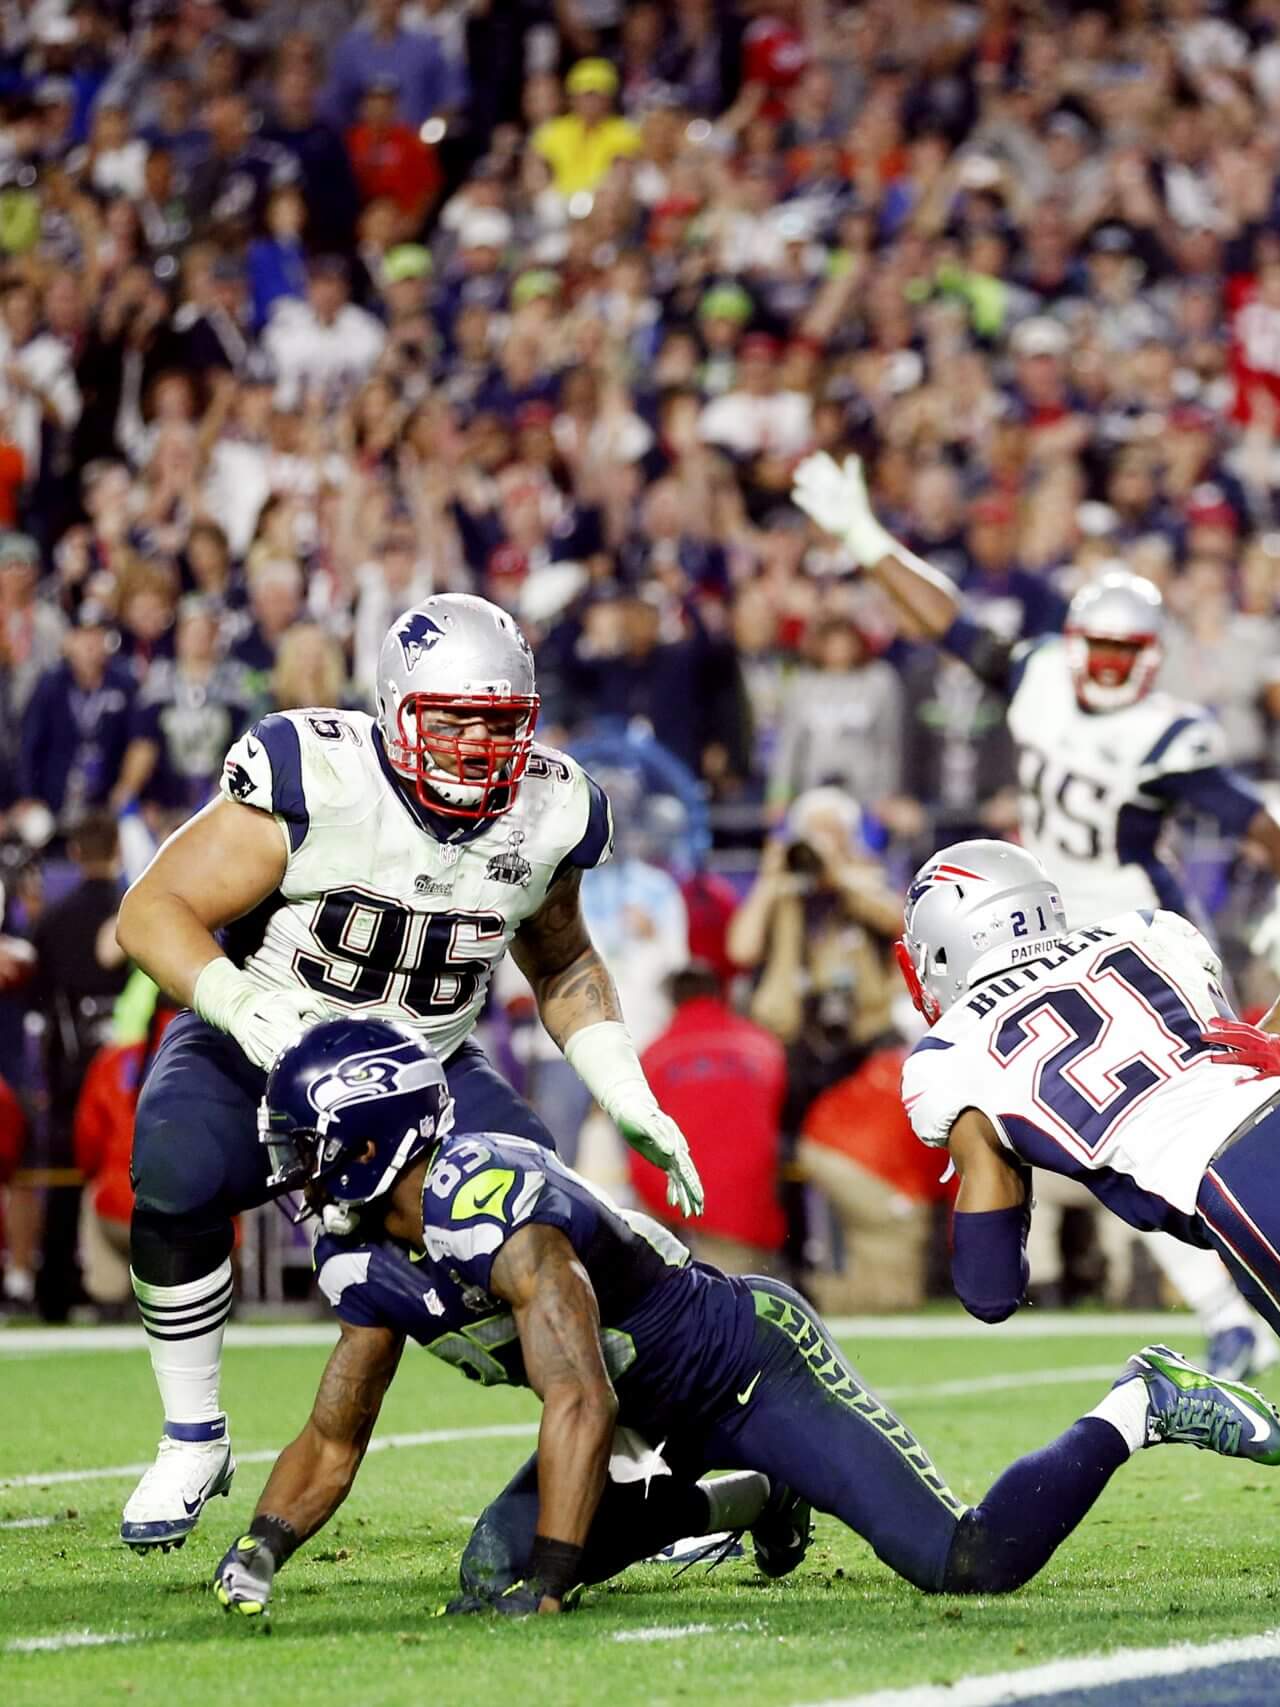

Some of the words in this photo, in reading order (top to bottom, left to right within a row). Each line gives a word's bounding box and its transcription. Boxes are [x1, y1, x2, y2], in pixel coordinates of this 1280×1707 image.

[291, 884, 506, 1020] 96
[1010, 906, 1047, 937] 21
[966, 926, 1117, 1020] BUTLER
[988, 940, 1238, 1160] 21
[424, 1140, 492, 1200] 83
